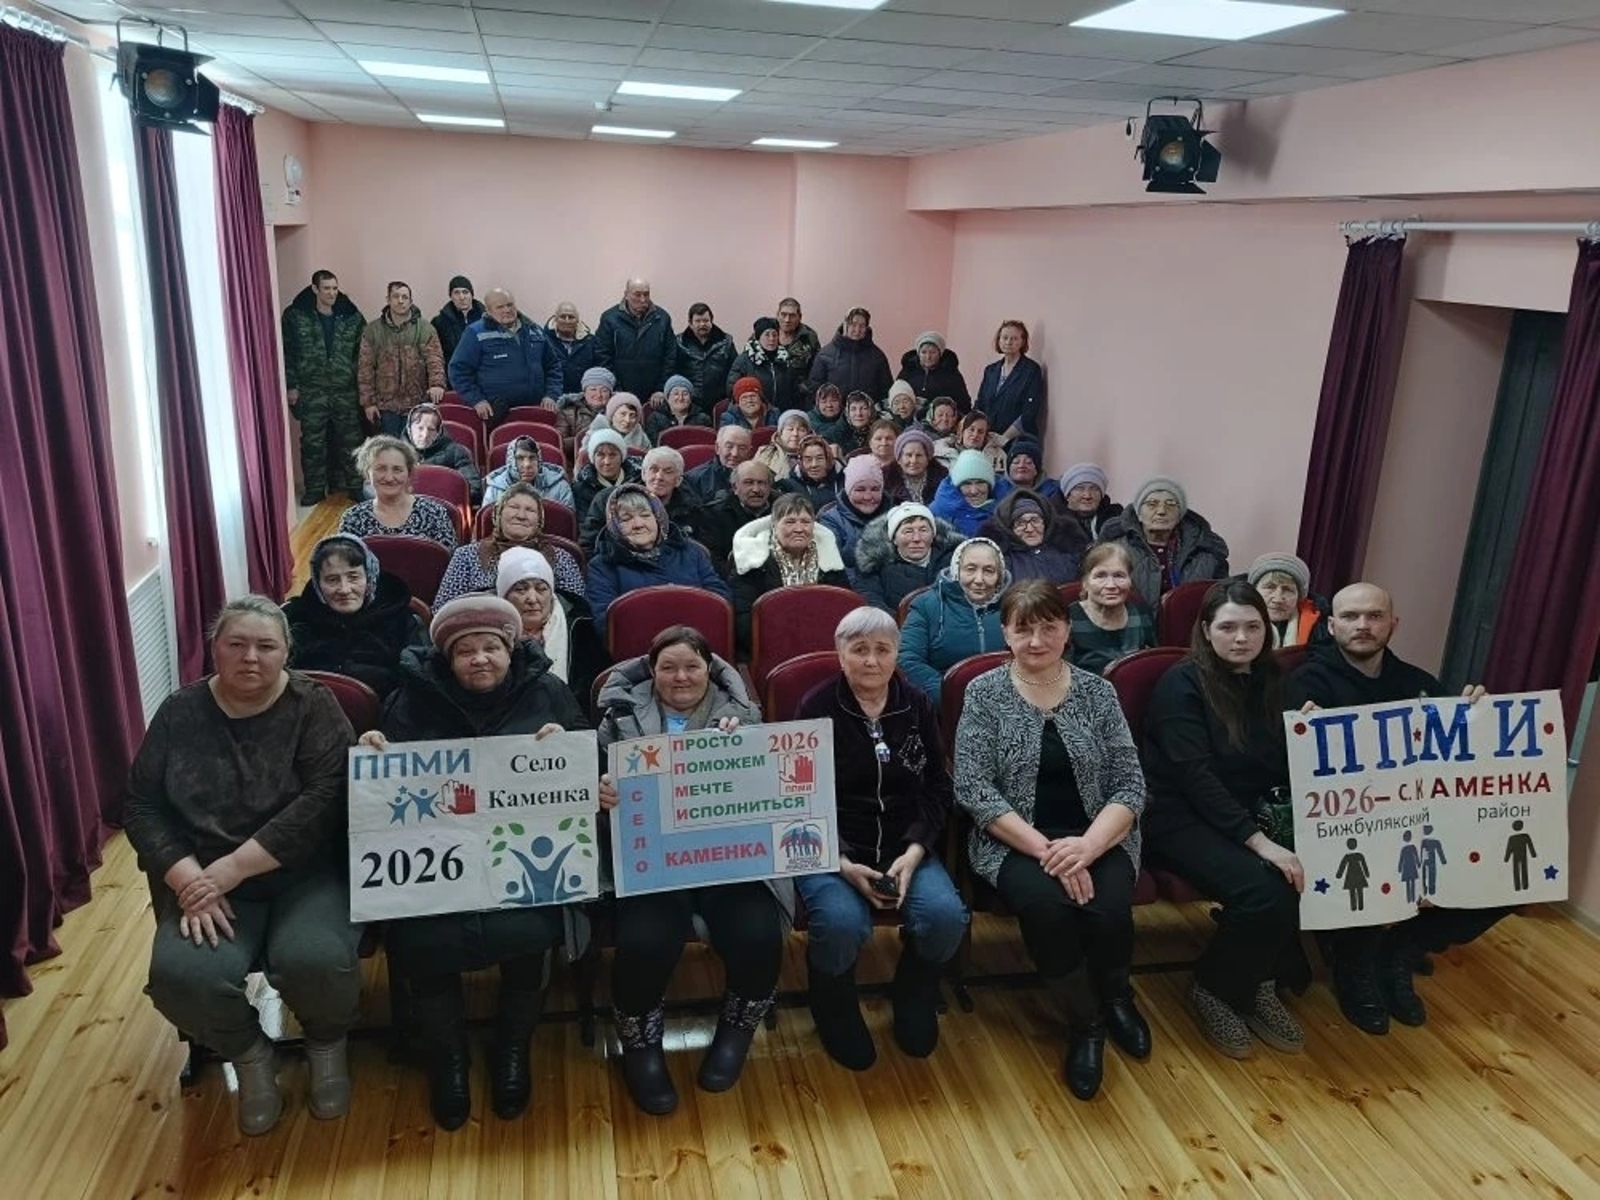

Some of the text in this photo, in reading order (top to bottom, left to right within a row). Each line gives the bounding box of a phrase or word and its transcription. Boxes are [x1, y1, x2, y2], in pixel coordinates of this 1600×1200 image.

[673, 735, 743, 751] ПРОСТО
[768, 731, 819, 753] 2026
[1309, 698, 1543, 776] ППМИ
[353, 748, 471, 780] ППМИ
[510, 754, 567, 773] Село
[674, 754, 766, 775] ПОМОЖЕМ
[488, 787, 590, 809] Каменка
[675, 781, 733, 798] МЕЧТЕ
[676, 796, 806, 821] ИСПОЛНИТЬСЯ
[631, 790, 649, 873] СЕЛО
[1316, 803, 1531, 840] Бижбулякский район
[361, 844, 464, 889] 2026
[665, 841, 767, 867] КАМЕНКА
